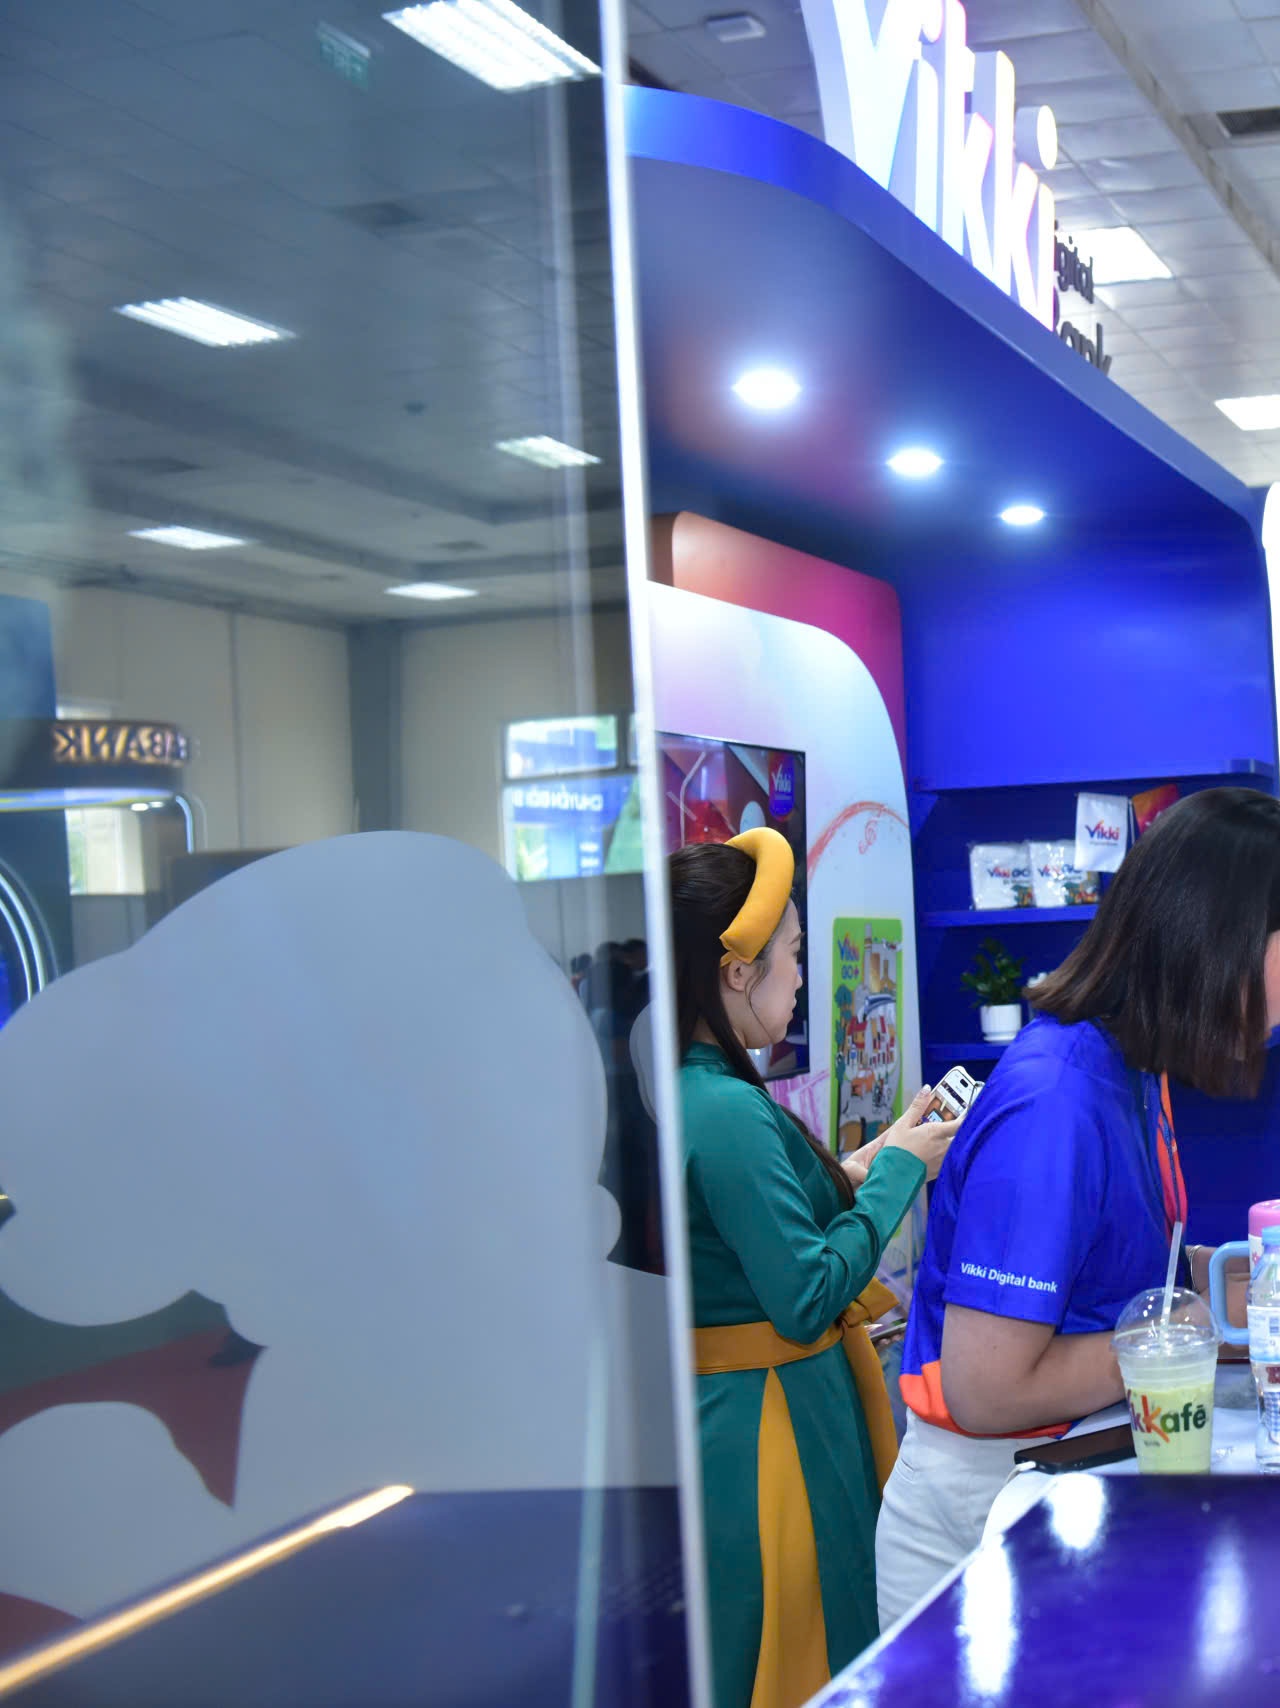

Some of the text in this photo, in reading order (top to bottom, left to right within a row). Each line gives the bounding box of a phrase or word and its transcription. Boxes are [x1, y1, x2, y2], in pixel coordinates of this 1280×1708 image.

[1085, 819, 1121, 841] Vikki
[961, 1262, 1058, 1293] Vikki Digital bank
